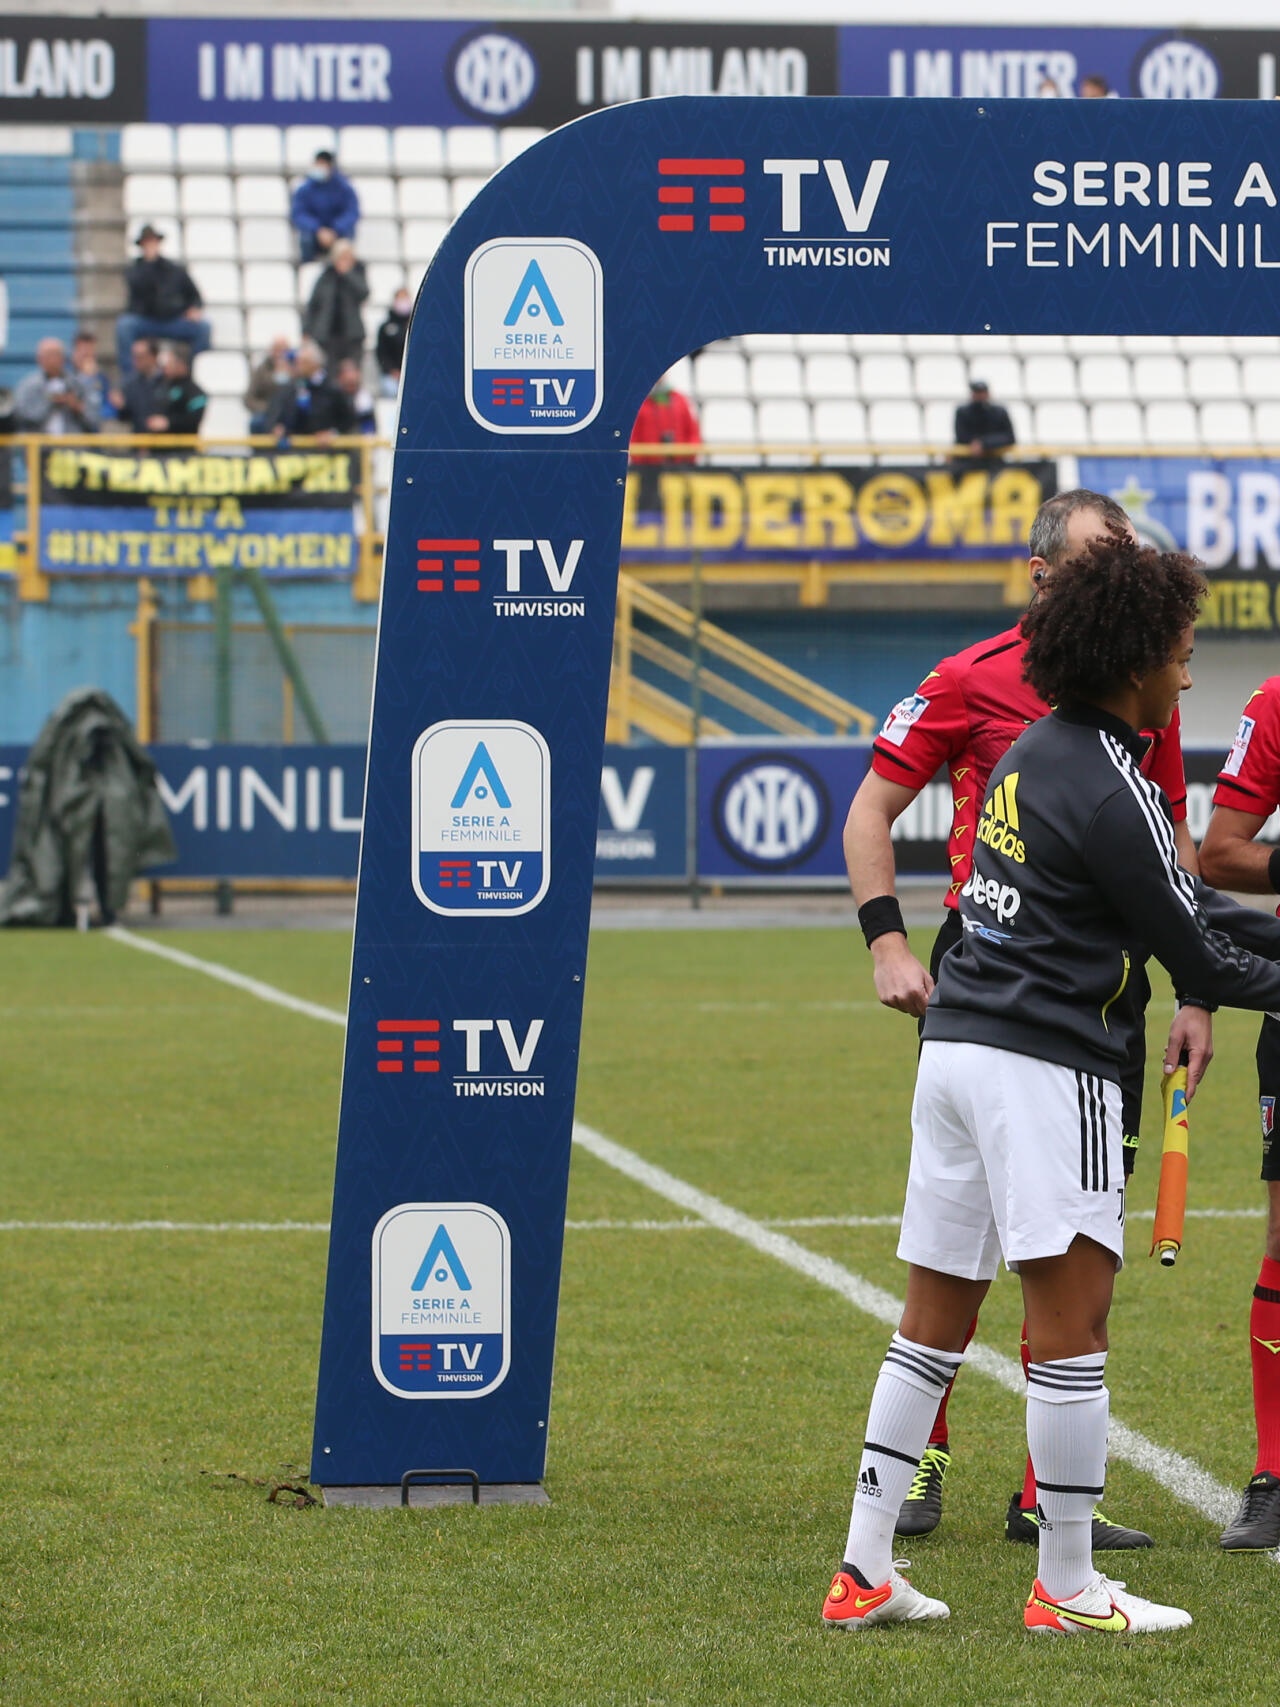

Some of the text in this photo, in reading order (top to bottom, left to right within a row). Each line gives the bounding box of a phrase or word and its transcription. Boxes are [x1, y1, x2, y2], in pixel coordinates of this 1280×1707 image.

[0, 40, 114, 98] LANO
[199, 43, 391, 101] I M INTER
[602, 47, 641, 101] M
[650, 47, 807, 97] MILANO
[914, 51, 953, 97] M
[960, 51, 1076, 97] INTER
[763, 159, 890, 233] TV
[1032, 160, 1277, 208] SERIE A
[763, 247, 890, 267] TIMVISION
[505, 333, 563, 345] SERIE A
[494, 347, 575, 360] FEMMINILE
[529, 378, 576, 406] TV
[530, 409, 576, 419] TIMVISION
[621, 469, 1041, 549] LIDEROMA
[493, 539, 585, 592] TV
[493, 602, 585, 617] TIMVISION
[1194, 580, 1272, 630] NTER
[155, 766, 363, 832] MINIL
[452, 815, 510, 827] SERIE A
[441, 829, 522, 842] FEMMINILE
[976, 815, 1026, 864] adidas
[476, 860, 523, 888] TV
[477, 891, 523, 900] TIMVISION
[961, 858, 1021, 924] Jeep
[452, 1019, 545, 1072] TV
[453, 1082, 545, 1097] TIMVISION
[412, 1298, 471, 1310] SERIE A
[401, 1312, 482, 1325] FEMMINILE
[437, 1343, 483, 1370] TV
[437, 1374, 483, 1382] TIMVISION
